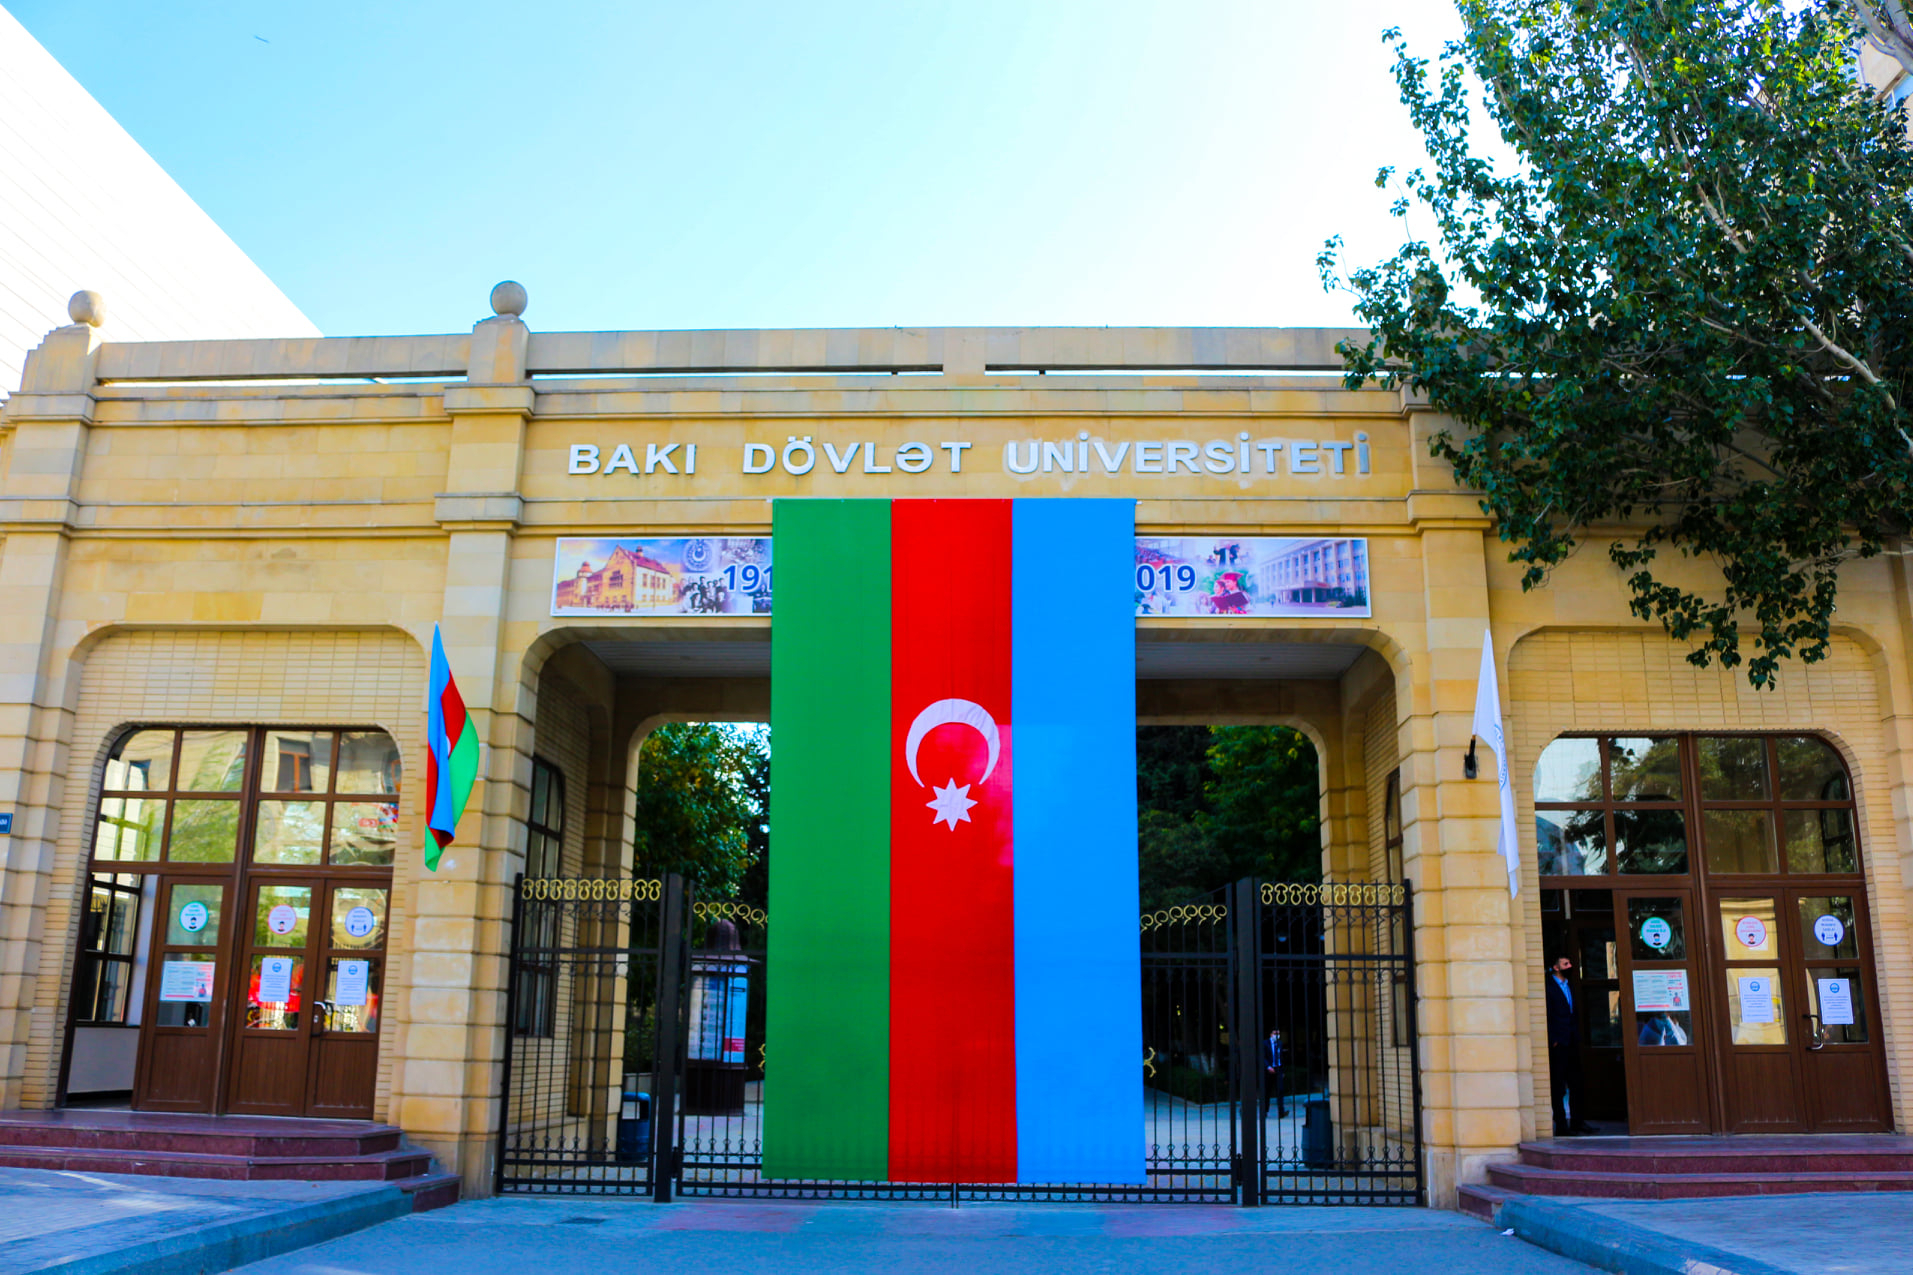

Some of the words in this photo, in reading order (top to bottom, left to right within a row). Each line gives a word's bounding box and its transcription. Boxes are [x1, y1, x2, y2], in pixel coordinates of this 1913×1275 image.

[568, 443, 697, 474] BAKI
[742, 436, 972, 475] DÖVLƏT
[1007, 432, 1370, 473] UNİVERSİTETİ
